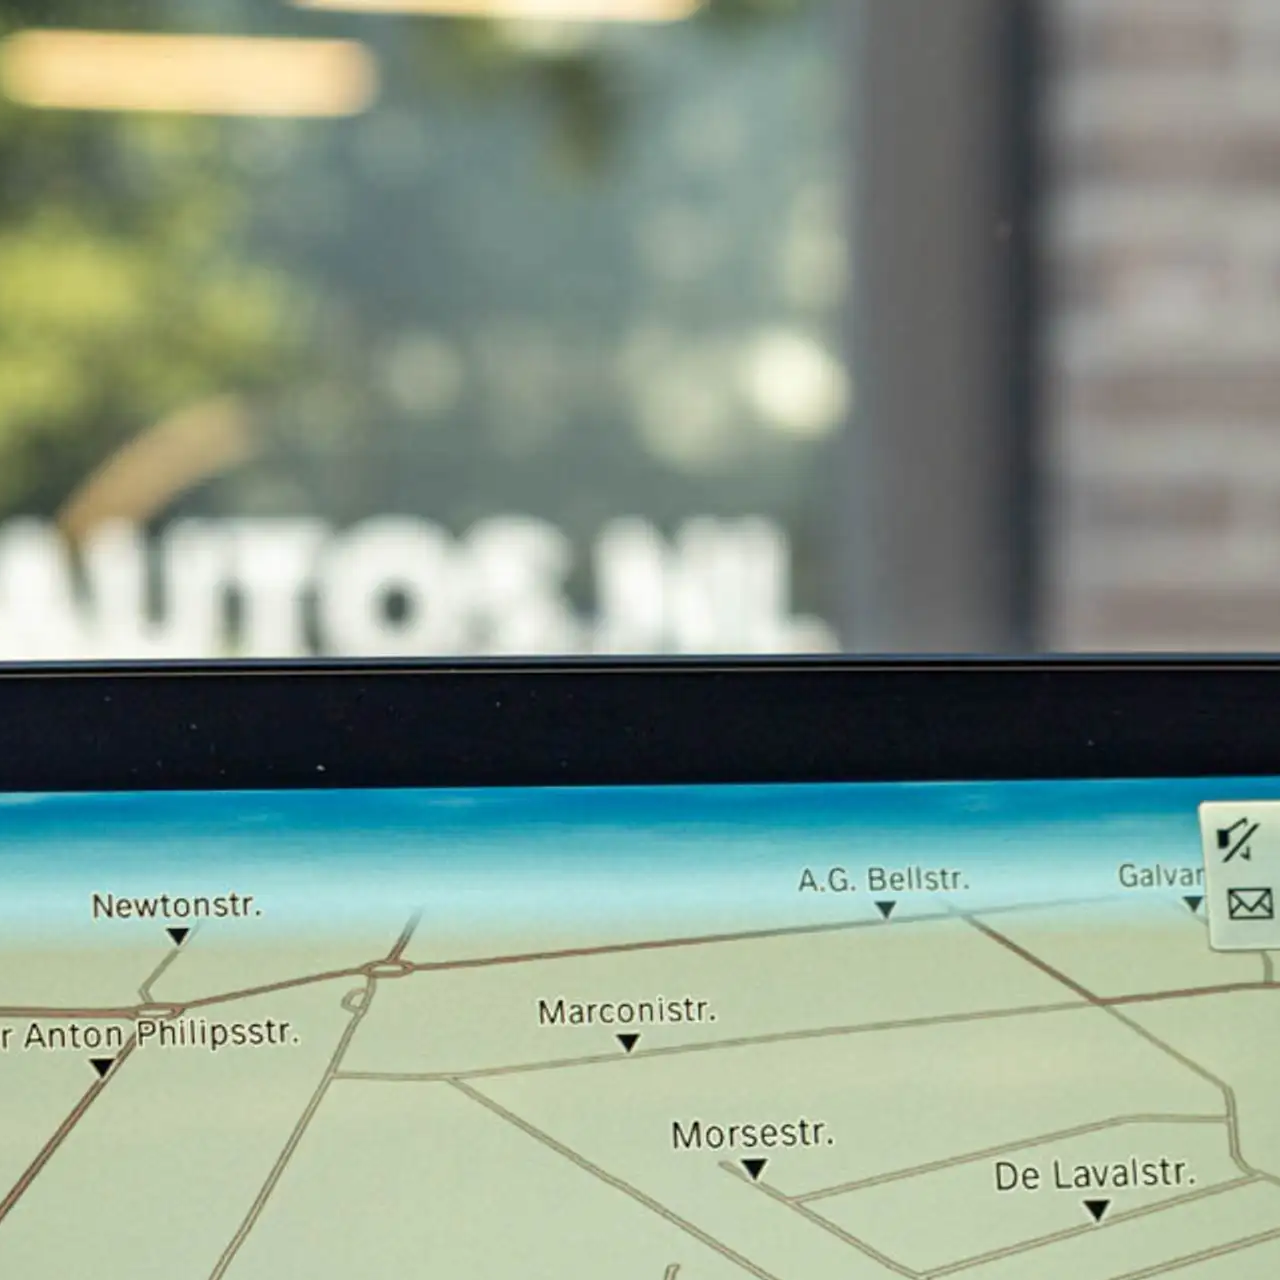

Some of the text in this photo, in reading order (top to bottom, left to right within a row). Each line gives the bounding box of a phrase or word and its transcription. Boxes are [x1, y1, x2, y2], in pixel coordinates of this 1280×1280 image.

[799, 865, 970, 893] A.G. Bellstr.
[92, 891, 263, 920] Newtonstr.
[538, 997, 717, 1025] Marconistr.
[24, 1021, 124, 1051] Anton
[136, 1018, 302, 1051] Philipsstr.
[671, 1119, 835, 1150] Morsestr.
[995, 1155, 1197, 1191] De Lavalstr.
